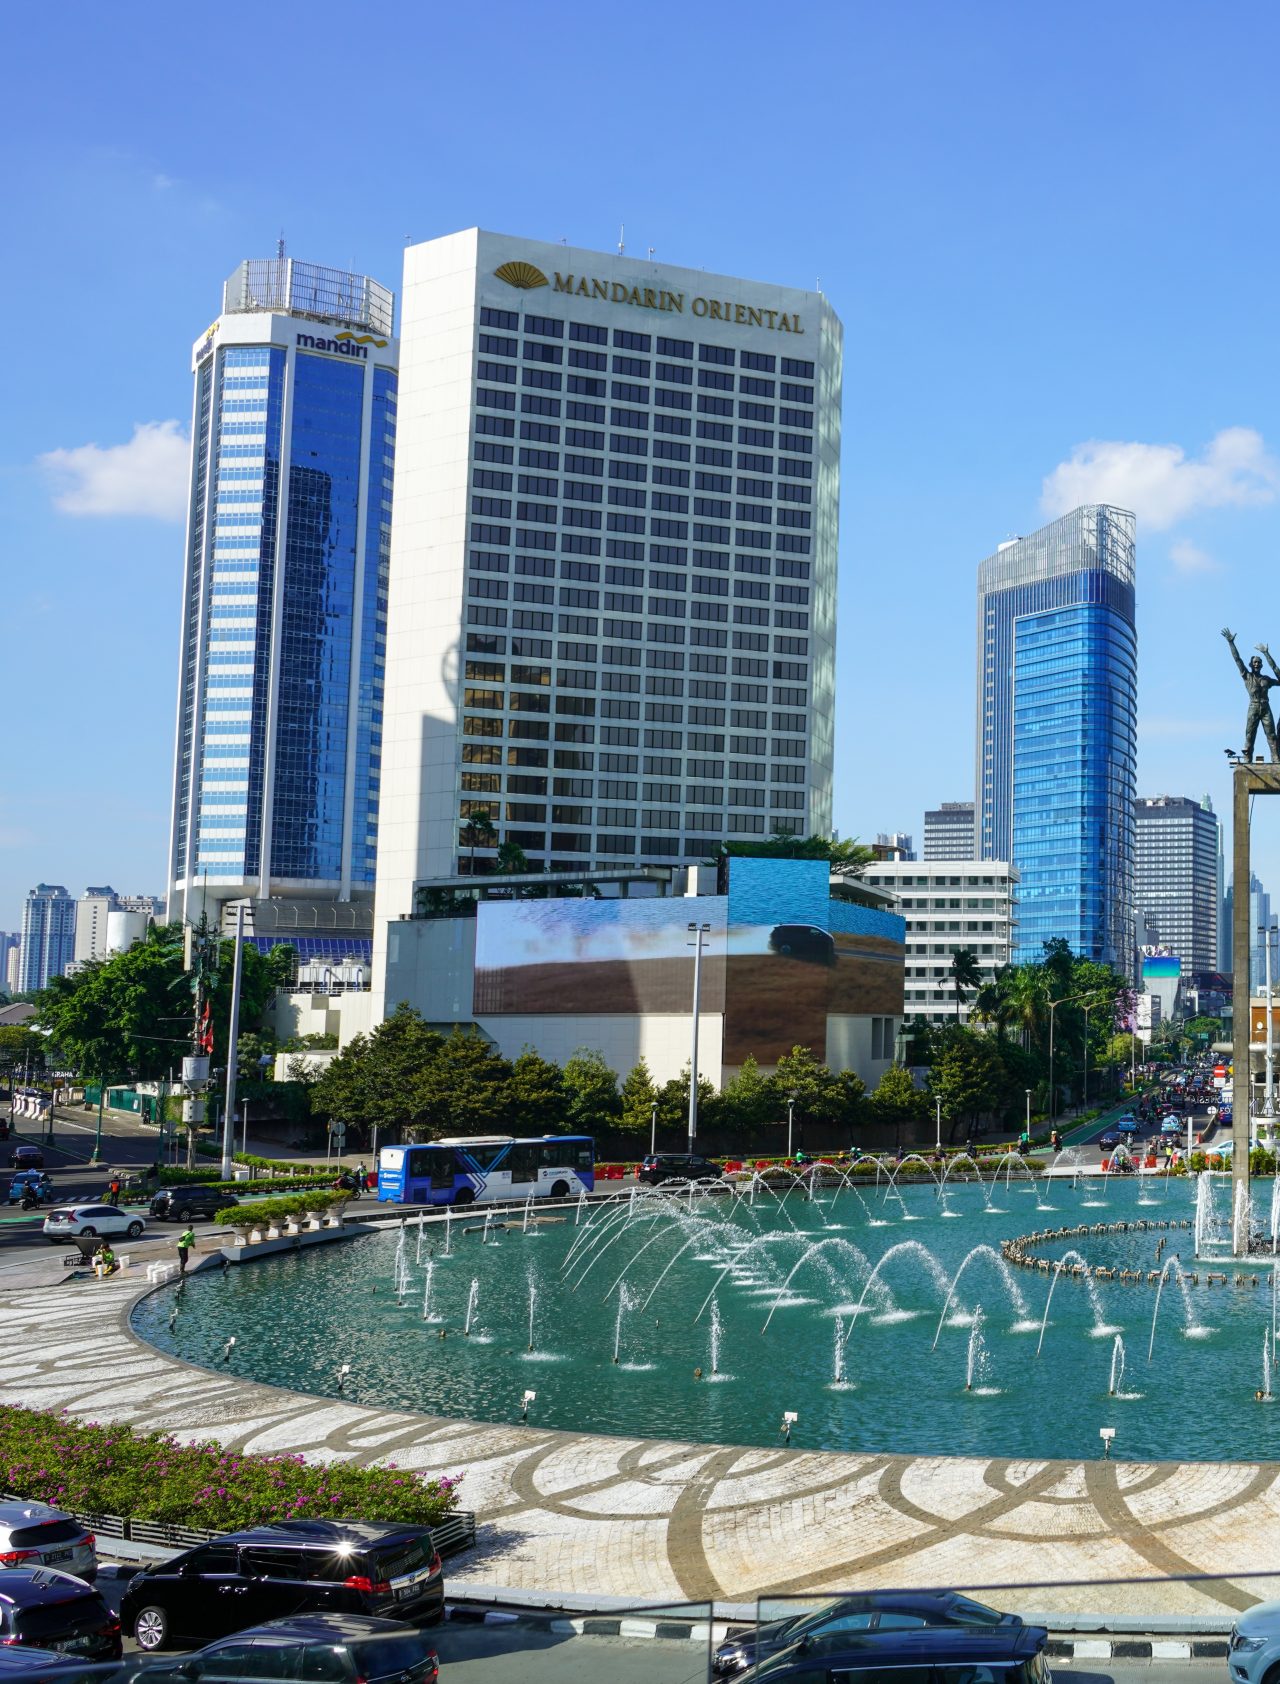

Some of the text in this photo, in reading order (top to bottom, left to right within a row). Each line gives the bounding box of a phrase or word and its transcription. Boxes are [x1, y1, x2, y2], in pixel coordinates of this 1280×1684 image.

[553, 272, 805, 335] MANDARIN ORIENTAL
[296, 333, 368, 358] mandiri
